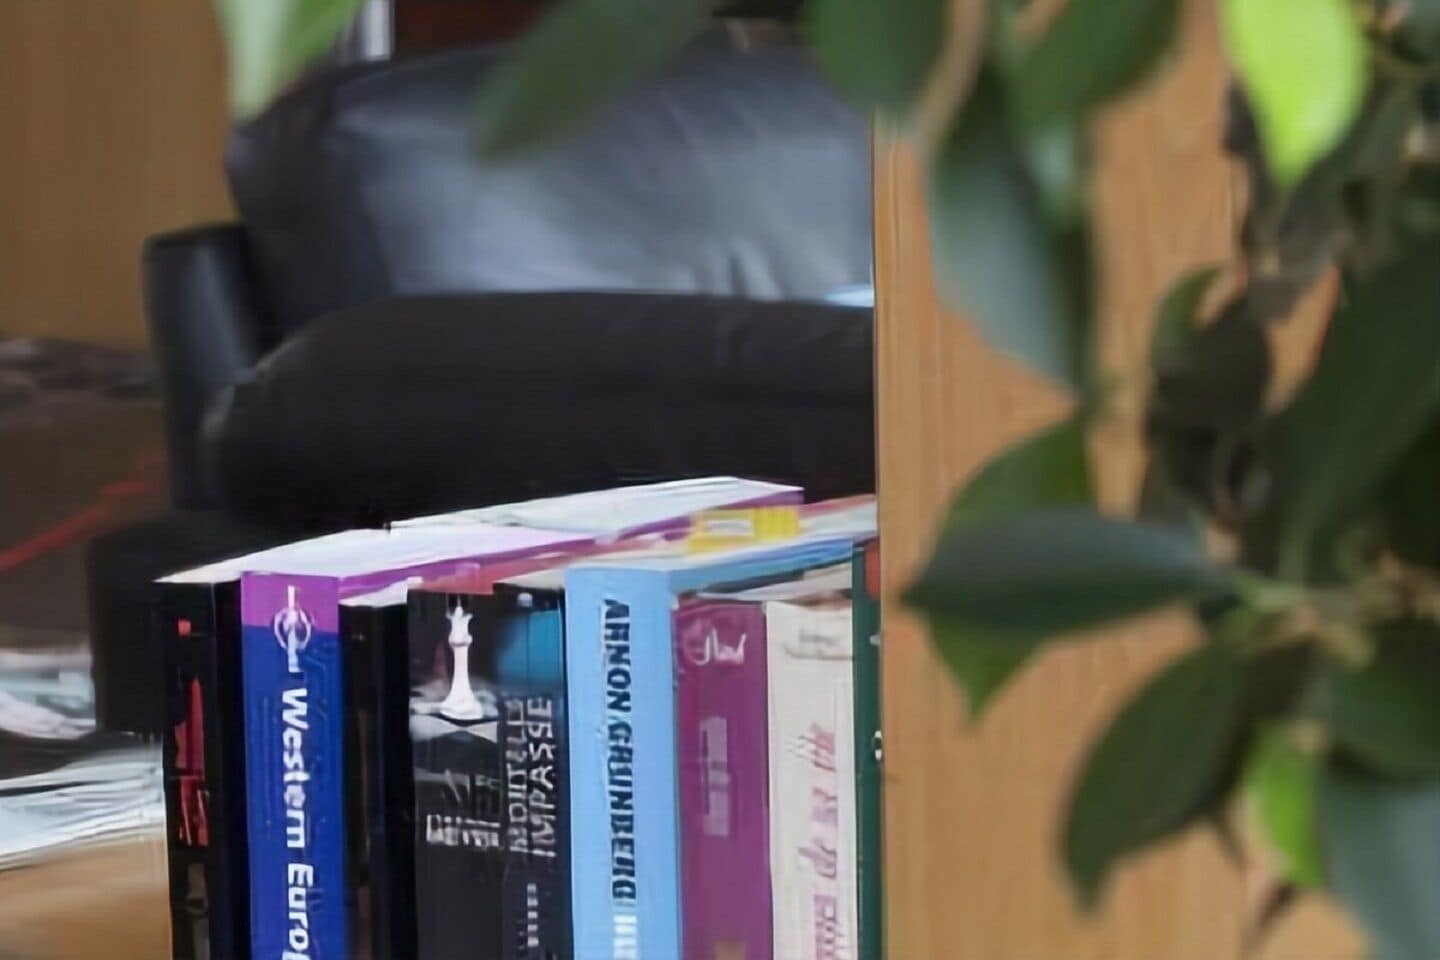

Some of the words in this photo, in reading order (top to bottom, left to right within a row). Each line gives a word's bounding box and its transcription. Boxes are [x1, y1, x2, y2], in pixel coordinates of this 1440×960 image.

[603, 598, 634, 713] ARNON
[281, 687, 314, 849] Western
[527, 697, 558, 858] IMPASSE
[606, 718, 638, 901] GRUNBERG
